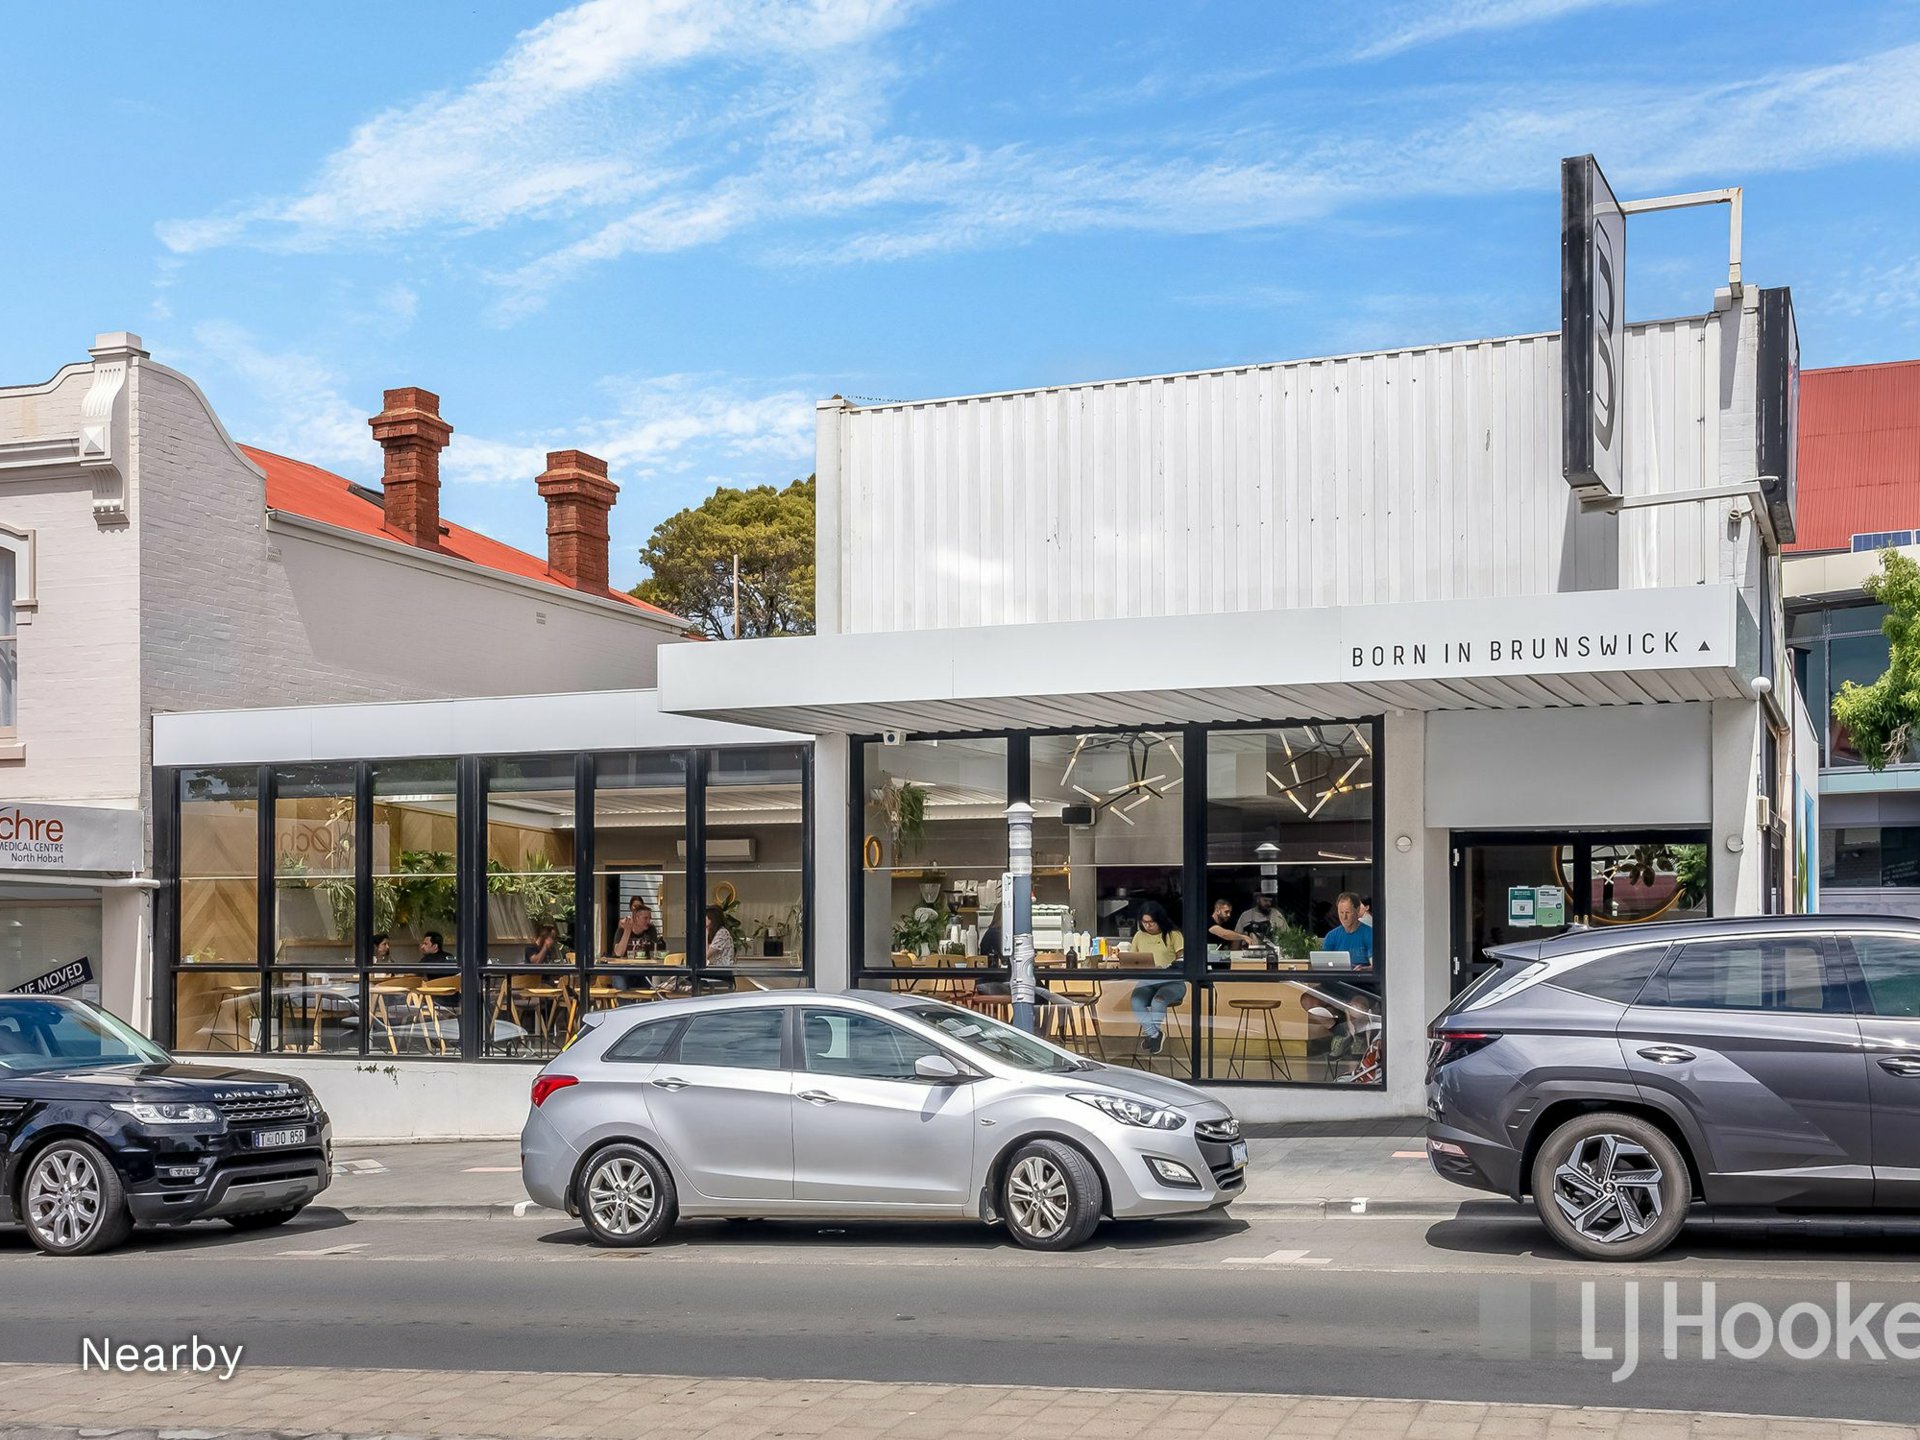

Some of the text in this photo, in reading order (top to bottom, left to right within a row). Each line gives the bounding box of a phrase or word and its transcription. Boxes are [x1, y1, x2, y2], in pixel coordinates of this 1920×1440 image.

[1352, 631, 1679, 667] BORN IN BRUNSWICK
[0, 809, 64, 842] chre
[34, 842, 64, 852] CENTRE
[11, 852, 64, 863] North Hobart
[37, 962, 83, 992] MOVED
[264, 1088, 300, 1096] ROVER
